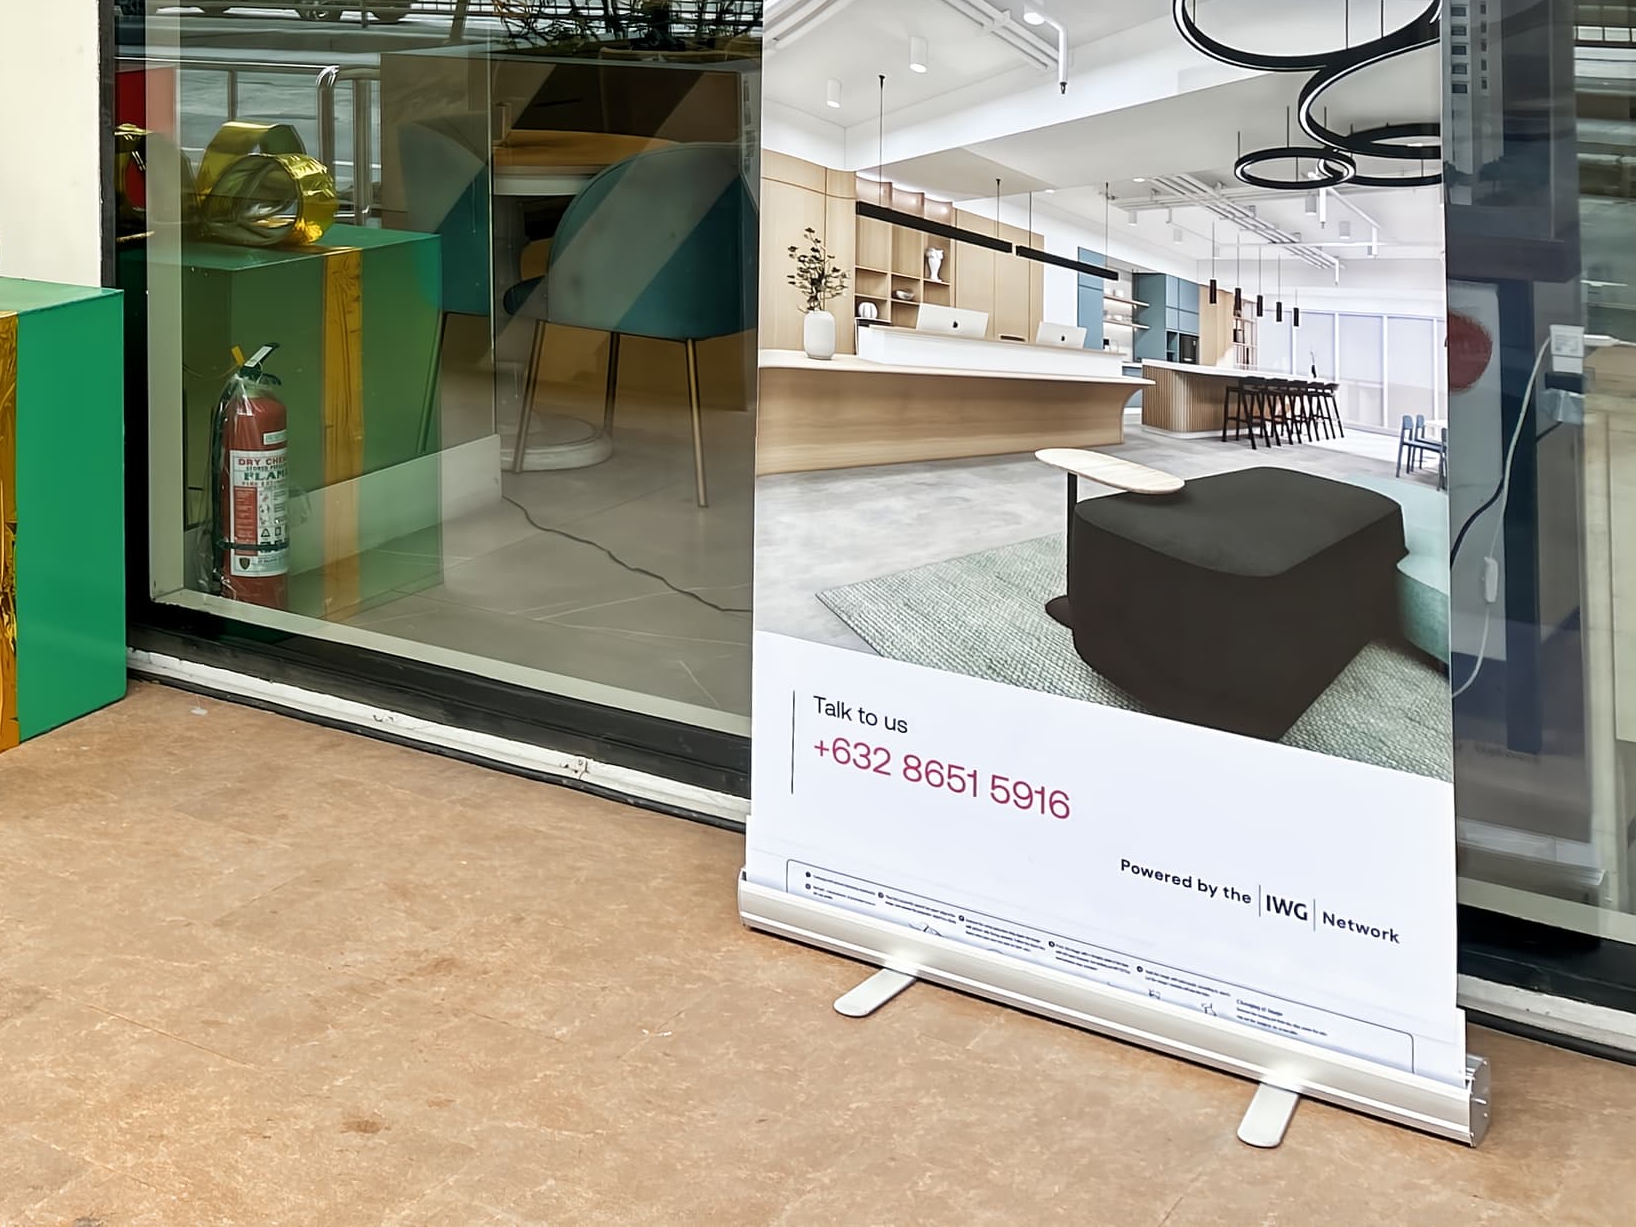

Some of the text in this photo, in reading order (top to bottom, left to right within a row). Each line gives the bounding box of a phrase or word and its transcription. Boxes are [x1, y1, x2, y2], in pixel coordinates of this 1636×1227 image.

[238, 458, 261, 466] DRY
[813, 695, 907, 733] Talk to us
[814, 738, 1070, 819] +632 8651 5916
[1121, 859, 1399, 944] Powered by the IWG Network
